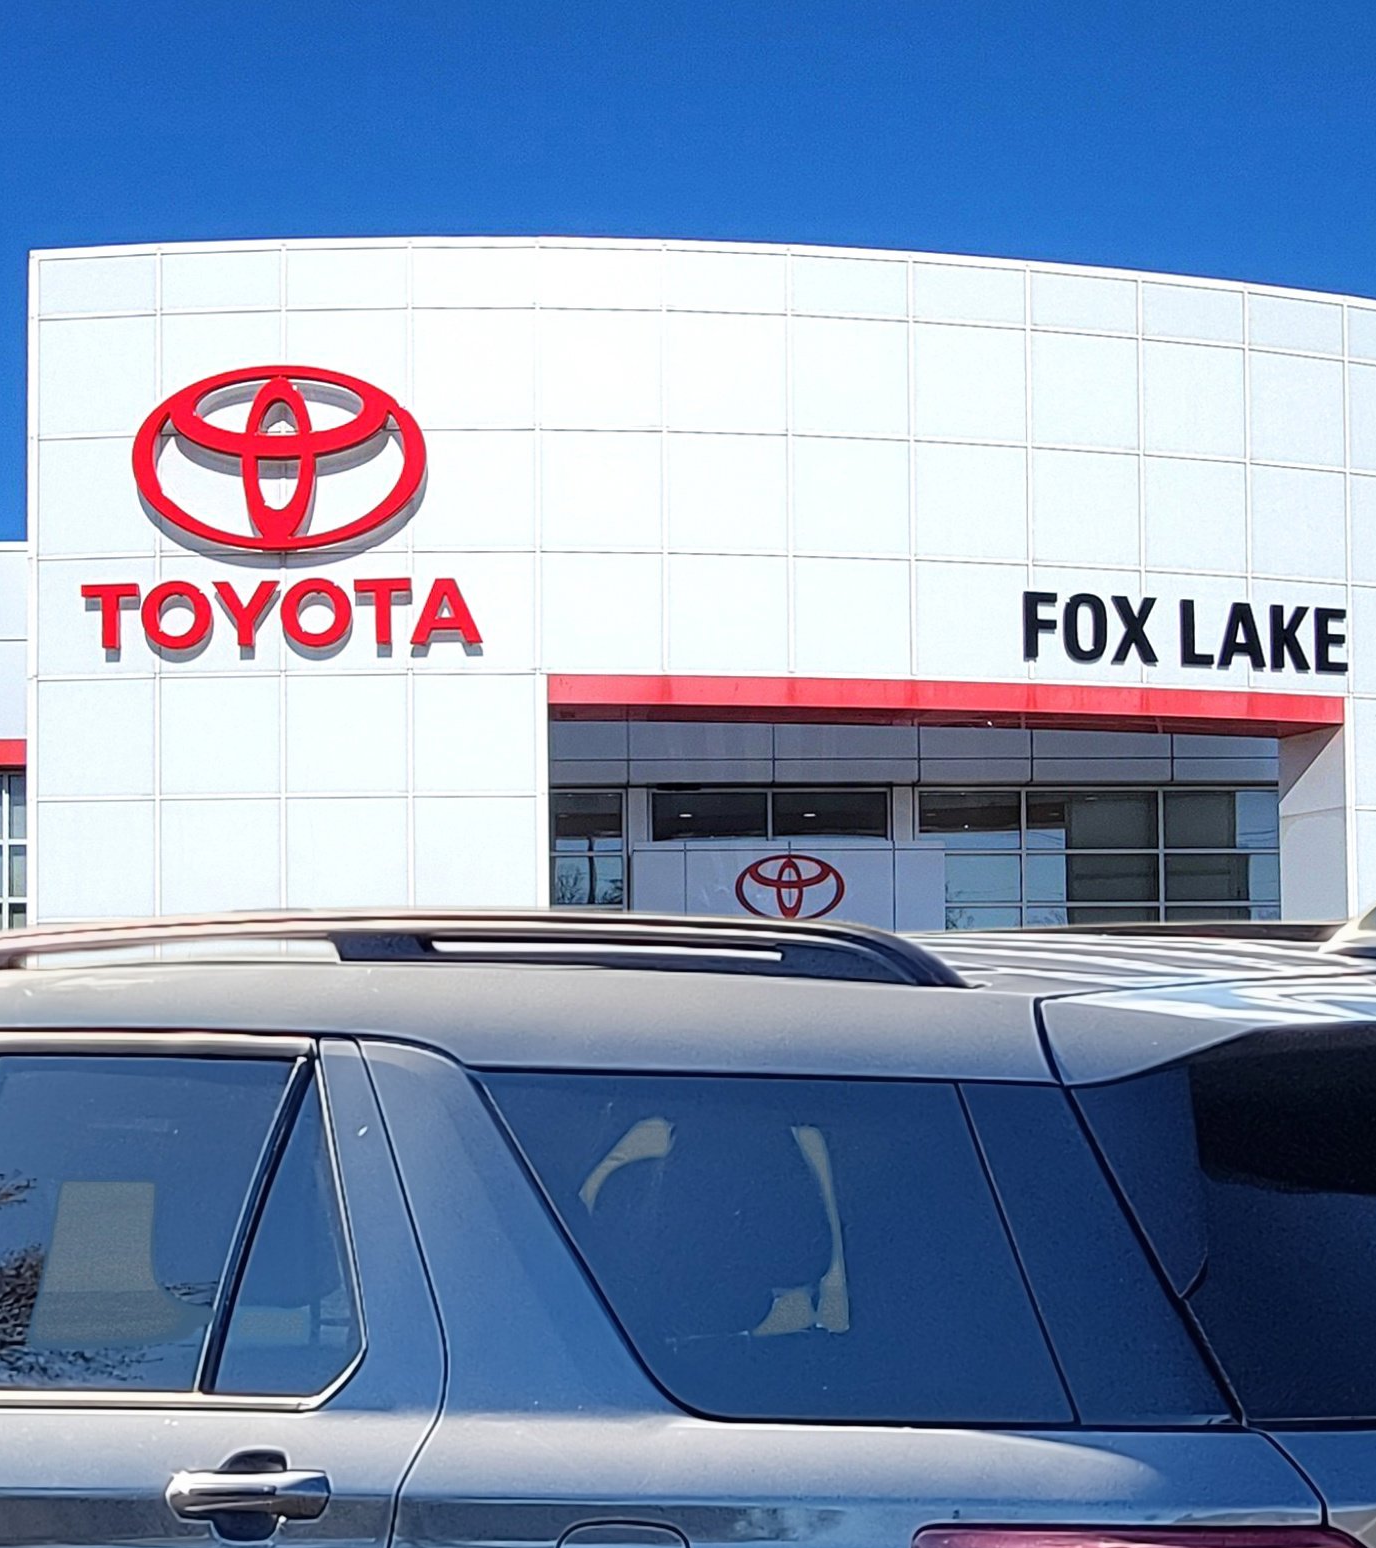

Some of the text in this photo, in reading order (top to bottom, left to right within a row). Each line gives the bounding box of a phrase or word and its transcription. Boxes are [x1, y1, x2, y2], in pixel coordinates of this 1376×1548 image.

[81, 578, 483, 652] TOYOTA
[1022, 591, 1349, 673] FOX LAKE
